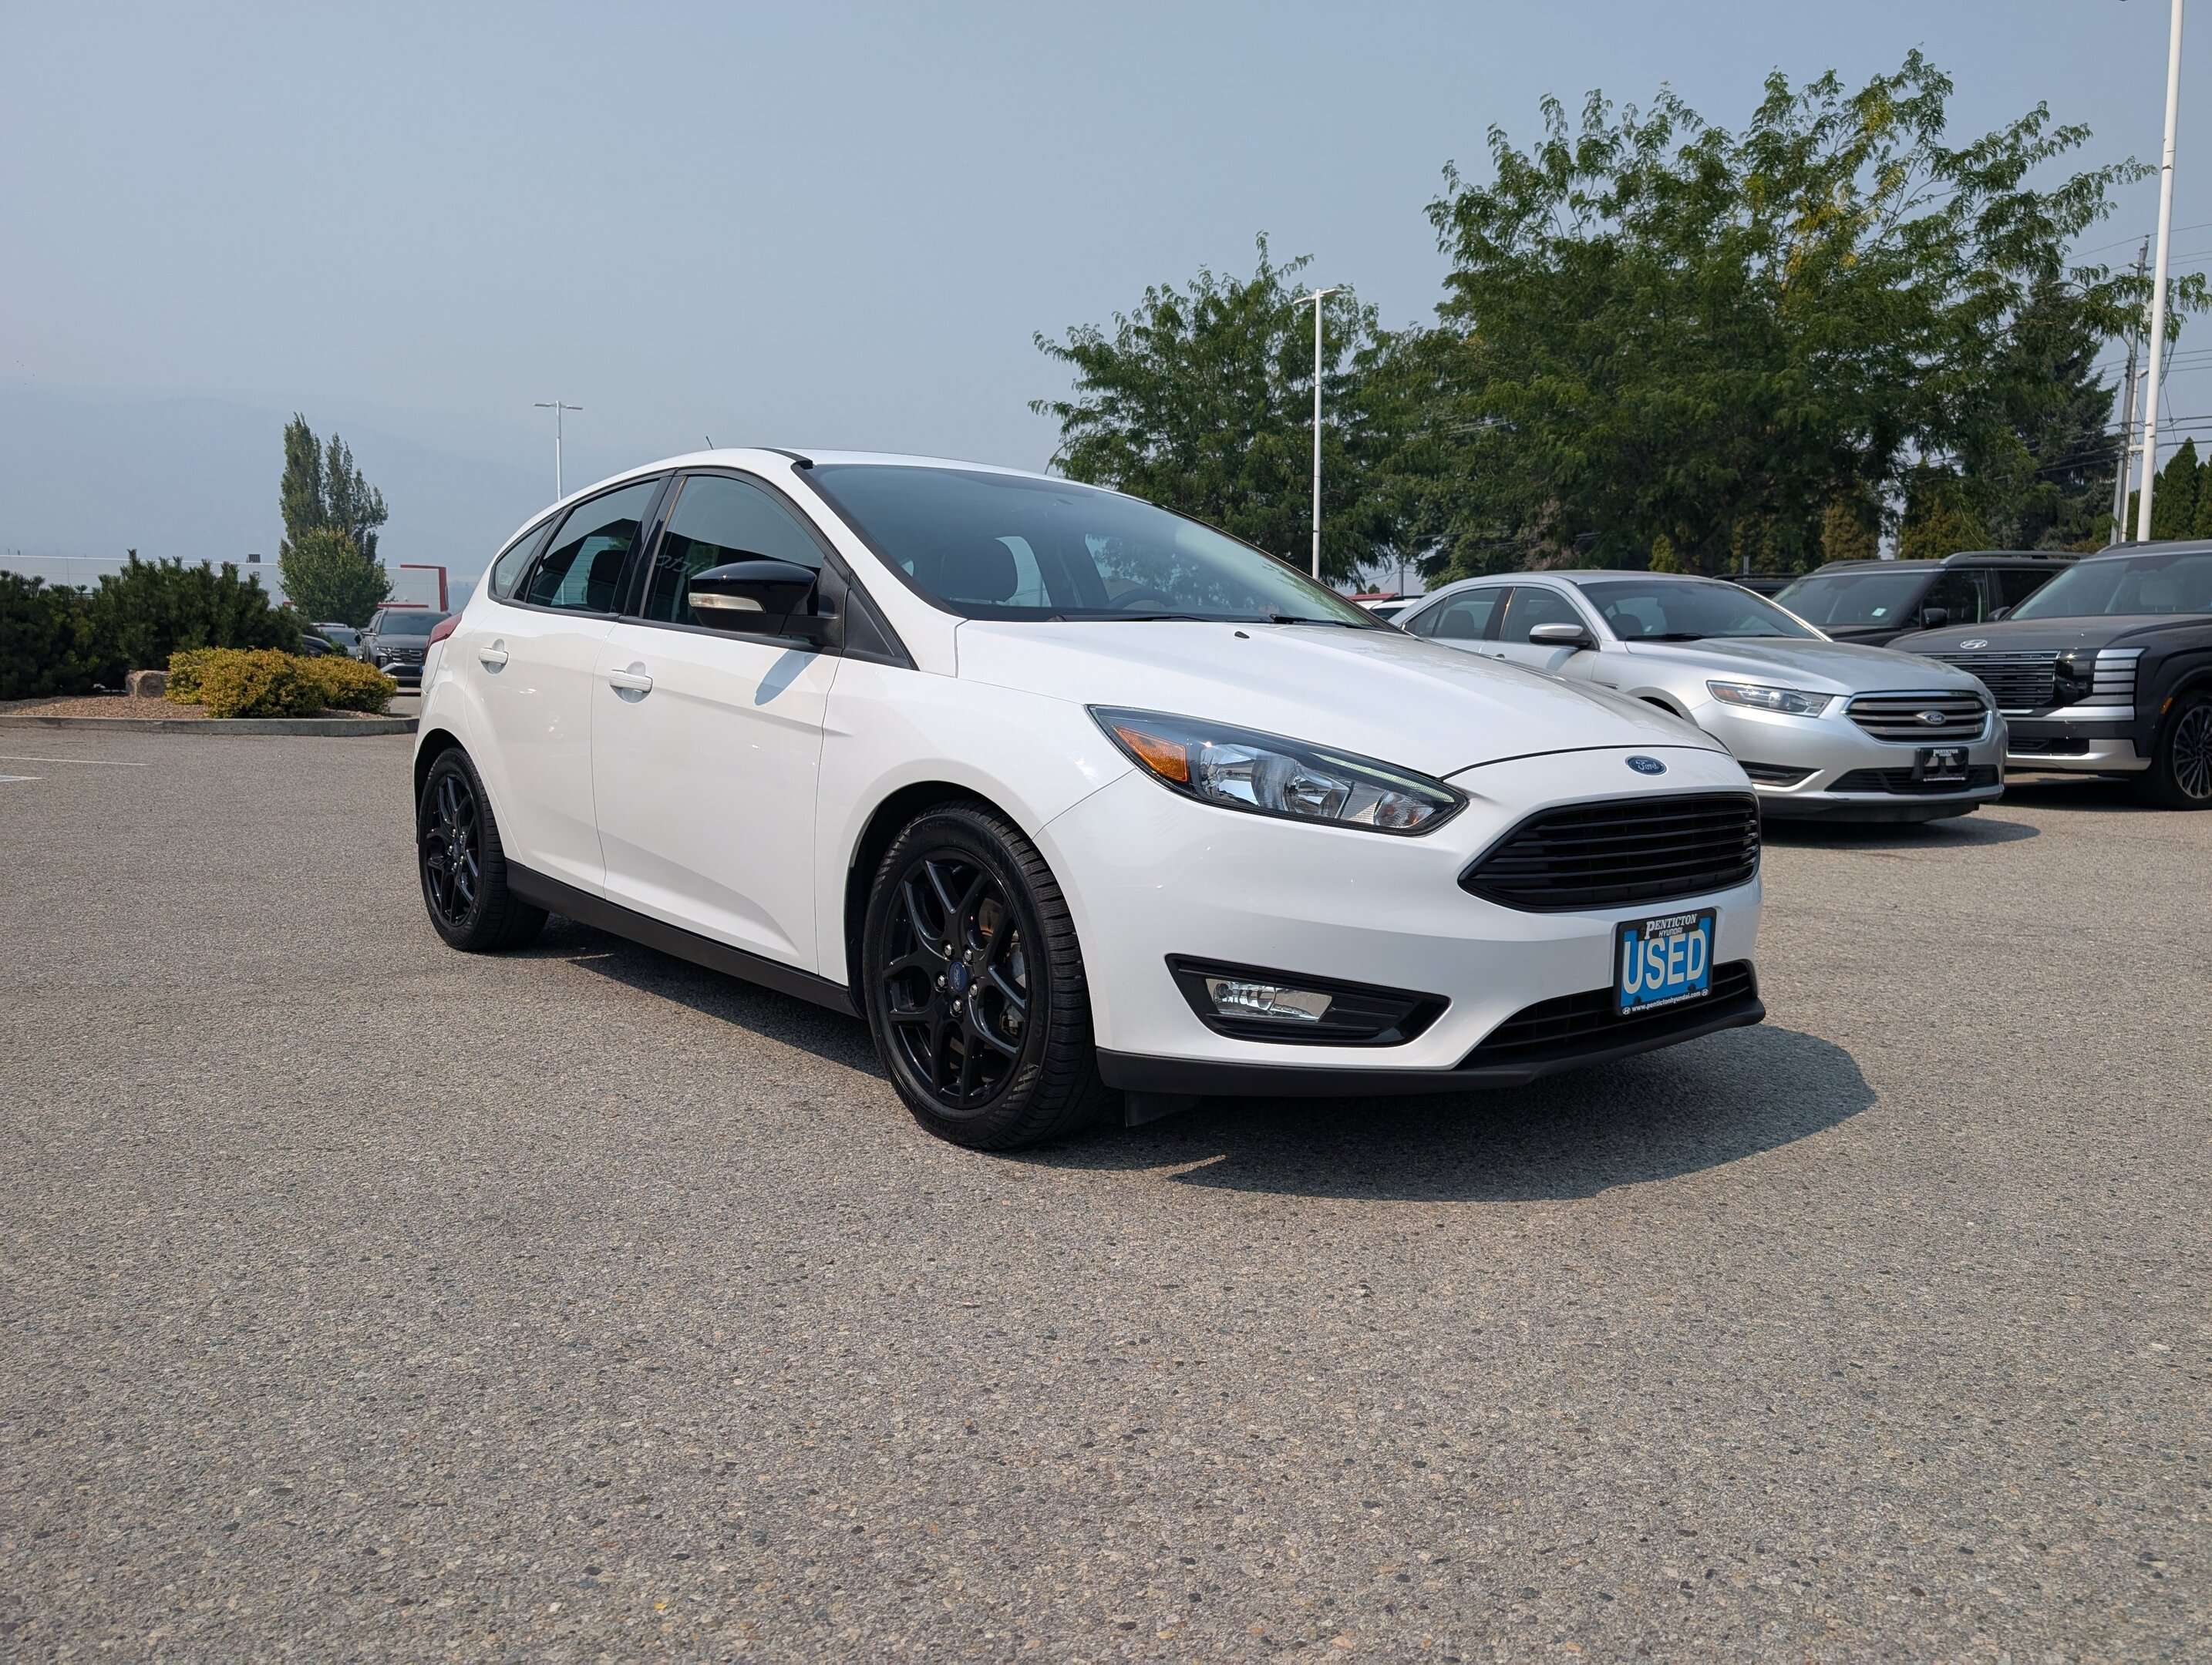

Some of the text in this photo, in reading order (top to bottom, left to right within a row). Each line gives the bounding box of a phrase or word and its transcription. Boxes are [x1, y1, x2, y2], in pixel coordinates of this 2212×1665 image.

[1635, 759, 1658, 770] Ford
[1645, 913, 1698, 940] PENTICTON
[1623, 929, 1706, 994] USED
